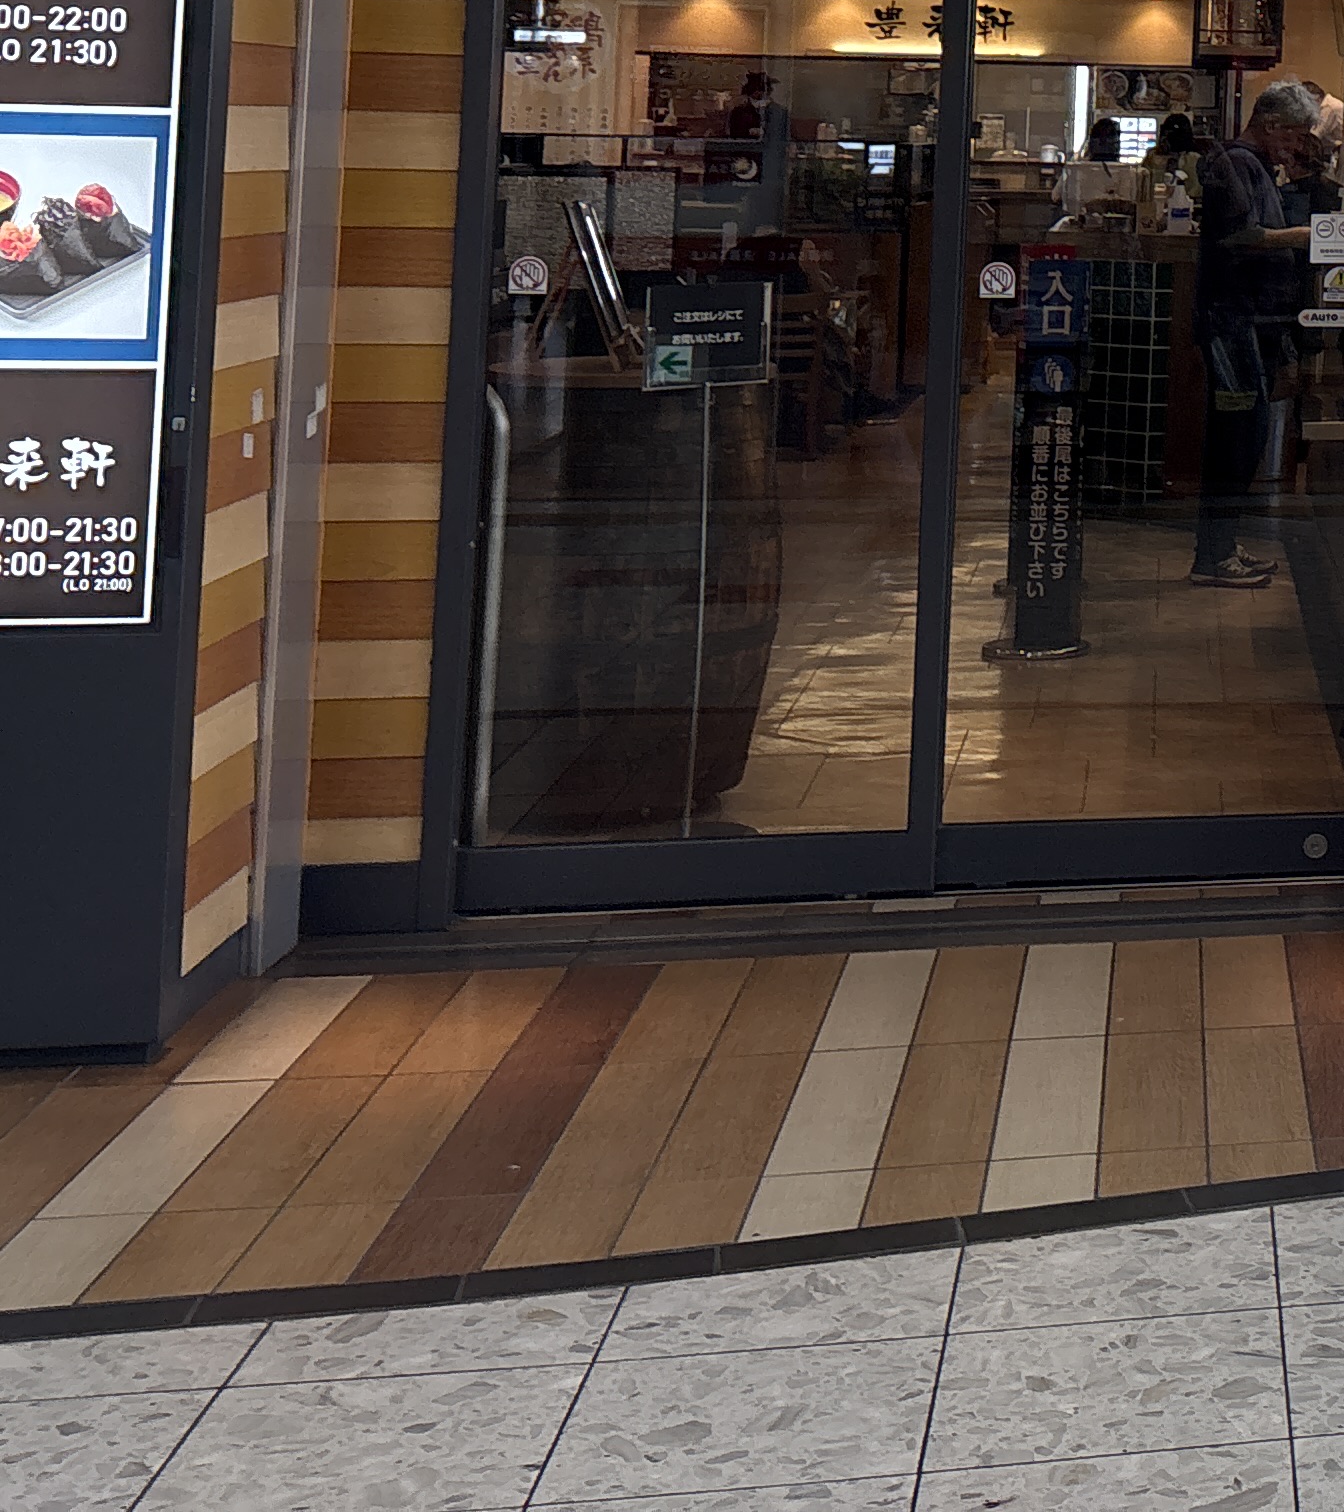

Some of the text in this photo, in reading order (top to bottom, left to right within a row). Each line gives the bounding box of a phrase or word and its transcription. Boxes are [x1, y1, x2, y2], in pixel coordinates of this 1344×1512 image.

[0, 37, 118, 67] O 21:30)
[1041, 270, 1074, 337] 入口
[1025, 425, 1051, 599] 順番にお並び下さい
[1048, 406, 1074, 581] 最後尾はこちらです
[0, 550, 136, 577] :00-21:30
[93, 577, 133, 594] 21:00)
